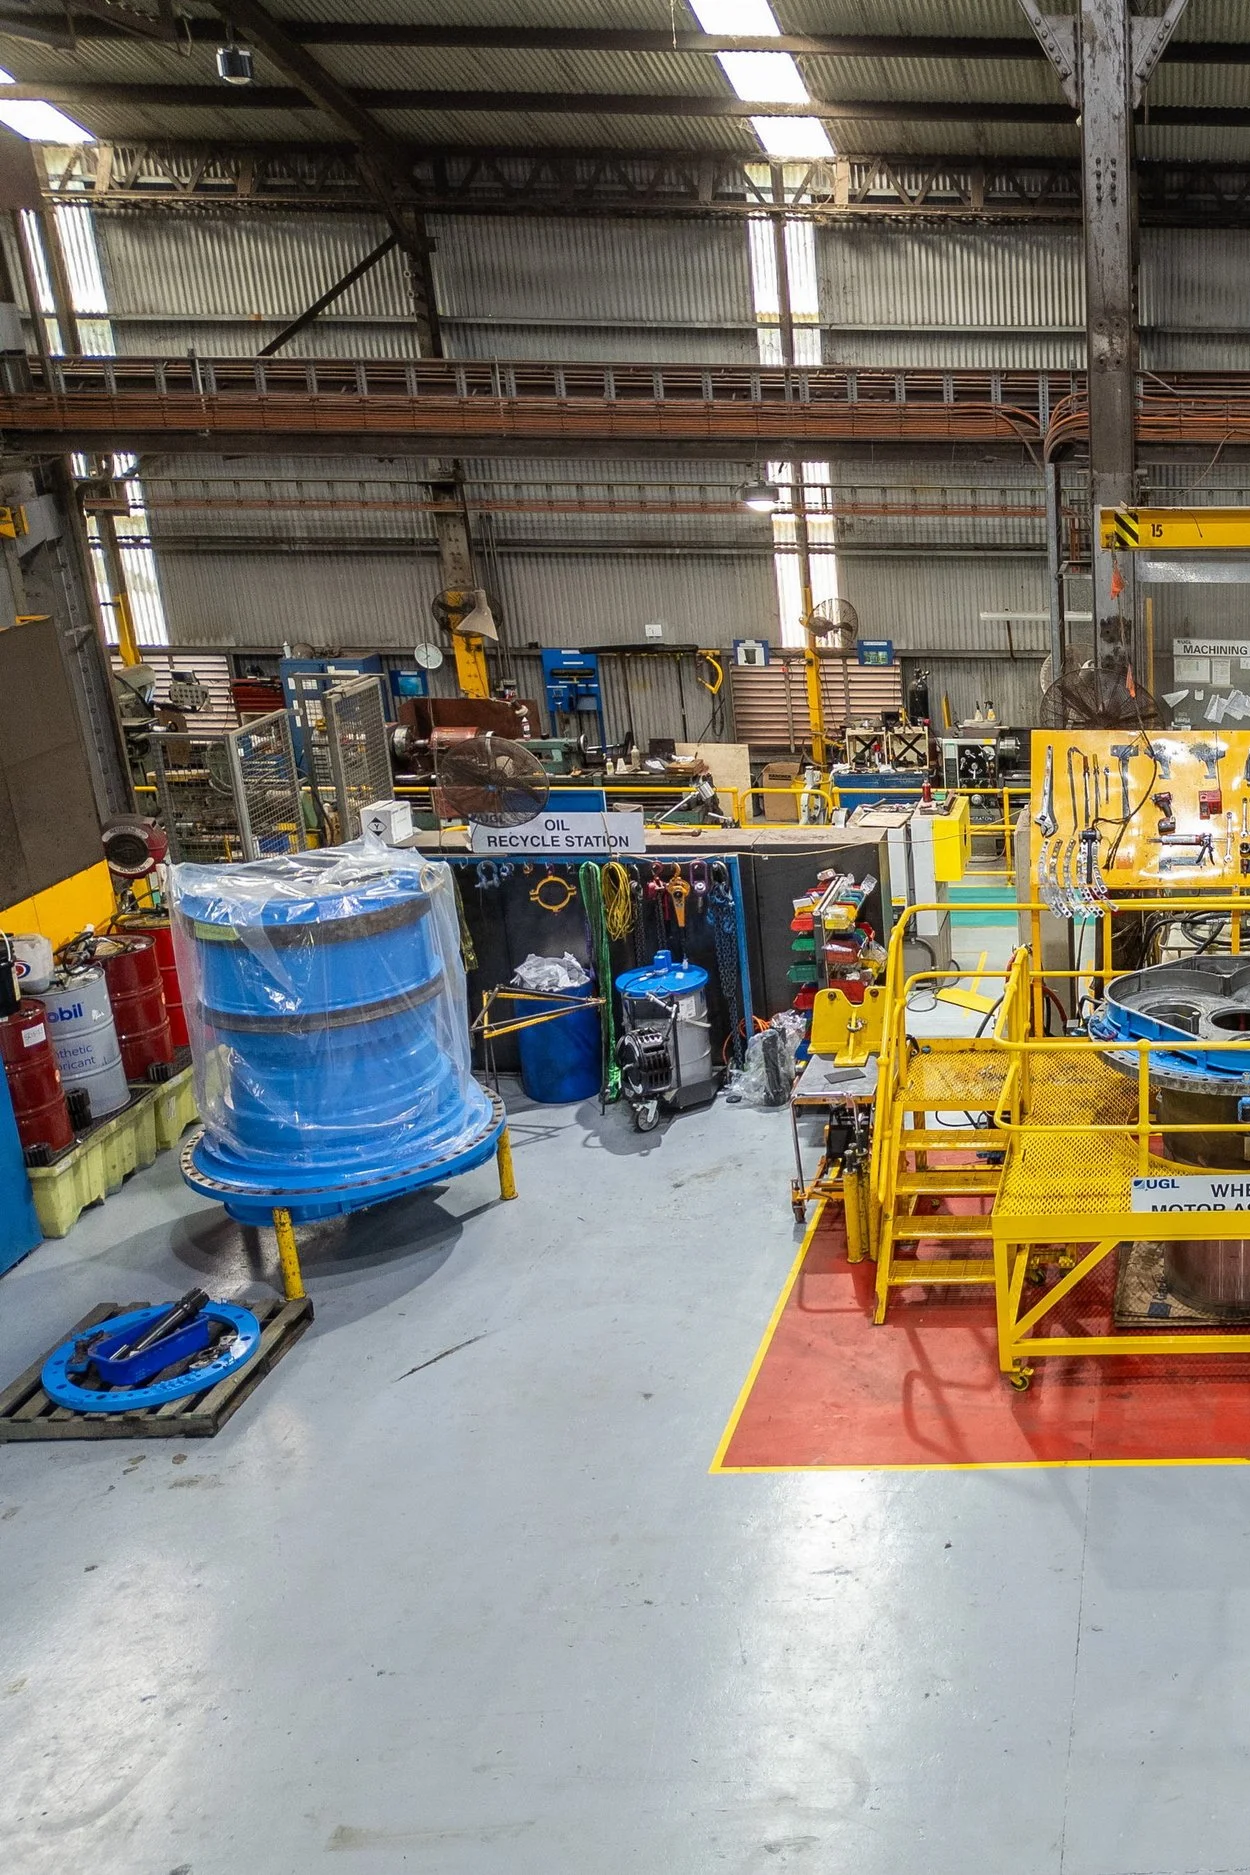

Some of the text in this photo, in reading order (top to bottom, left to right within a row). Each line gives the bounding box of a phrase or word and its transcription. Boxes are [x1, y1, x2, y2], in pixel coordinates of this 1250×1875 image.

[1151, 524, 1163, 537] 15
[1183, 645, 1248, 655] MACHINING
[544, 819, 570, 831] OIL
[487, 835, 629, 848] RECYCLE STATION
[47, 1003, 83, 1023] obil
[55, 1045, 93, 1059] nthetic
[1146, 1178, 1180, 1190] UGL
